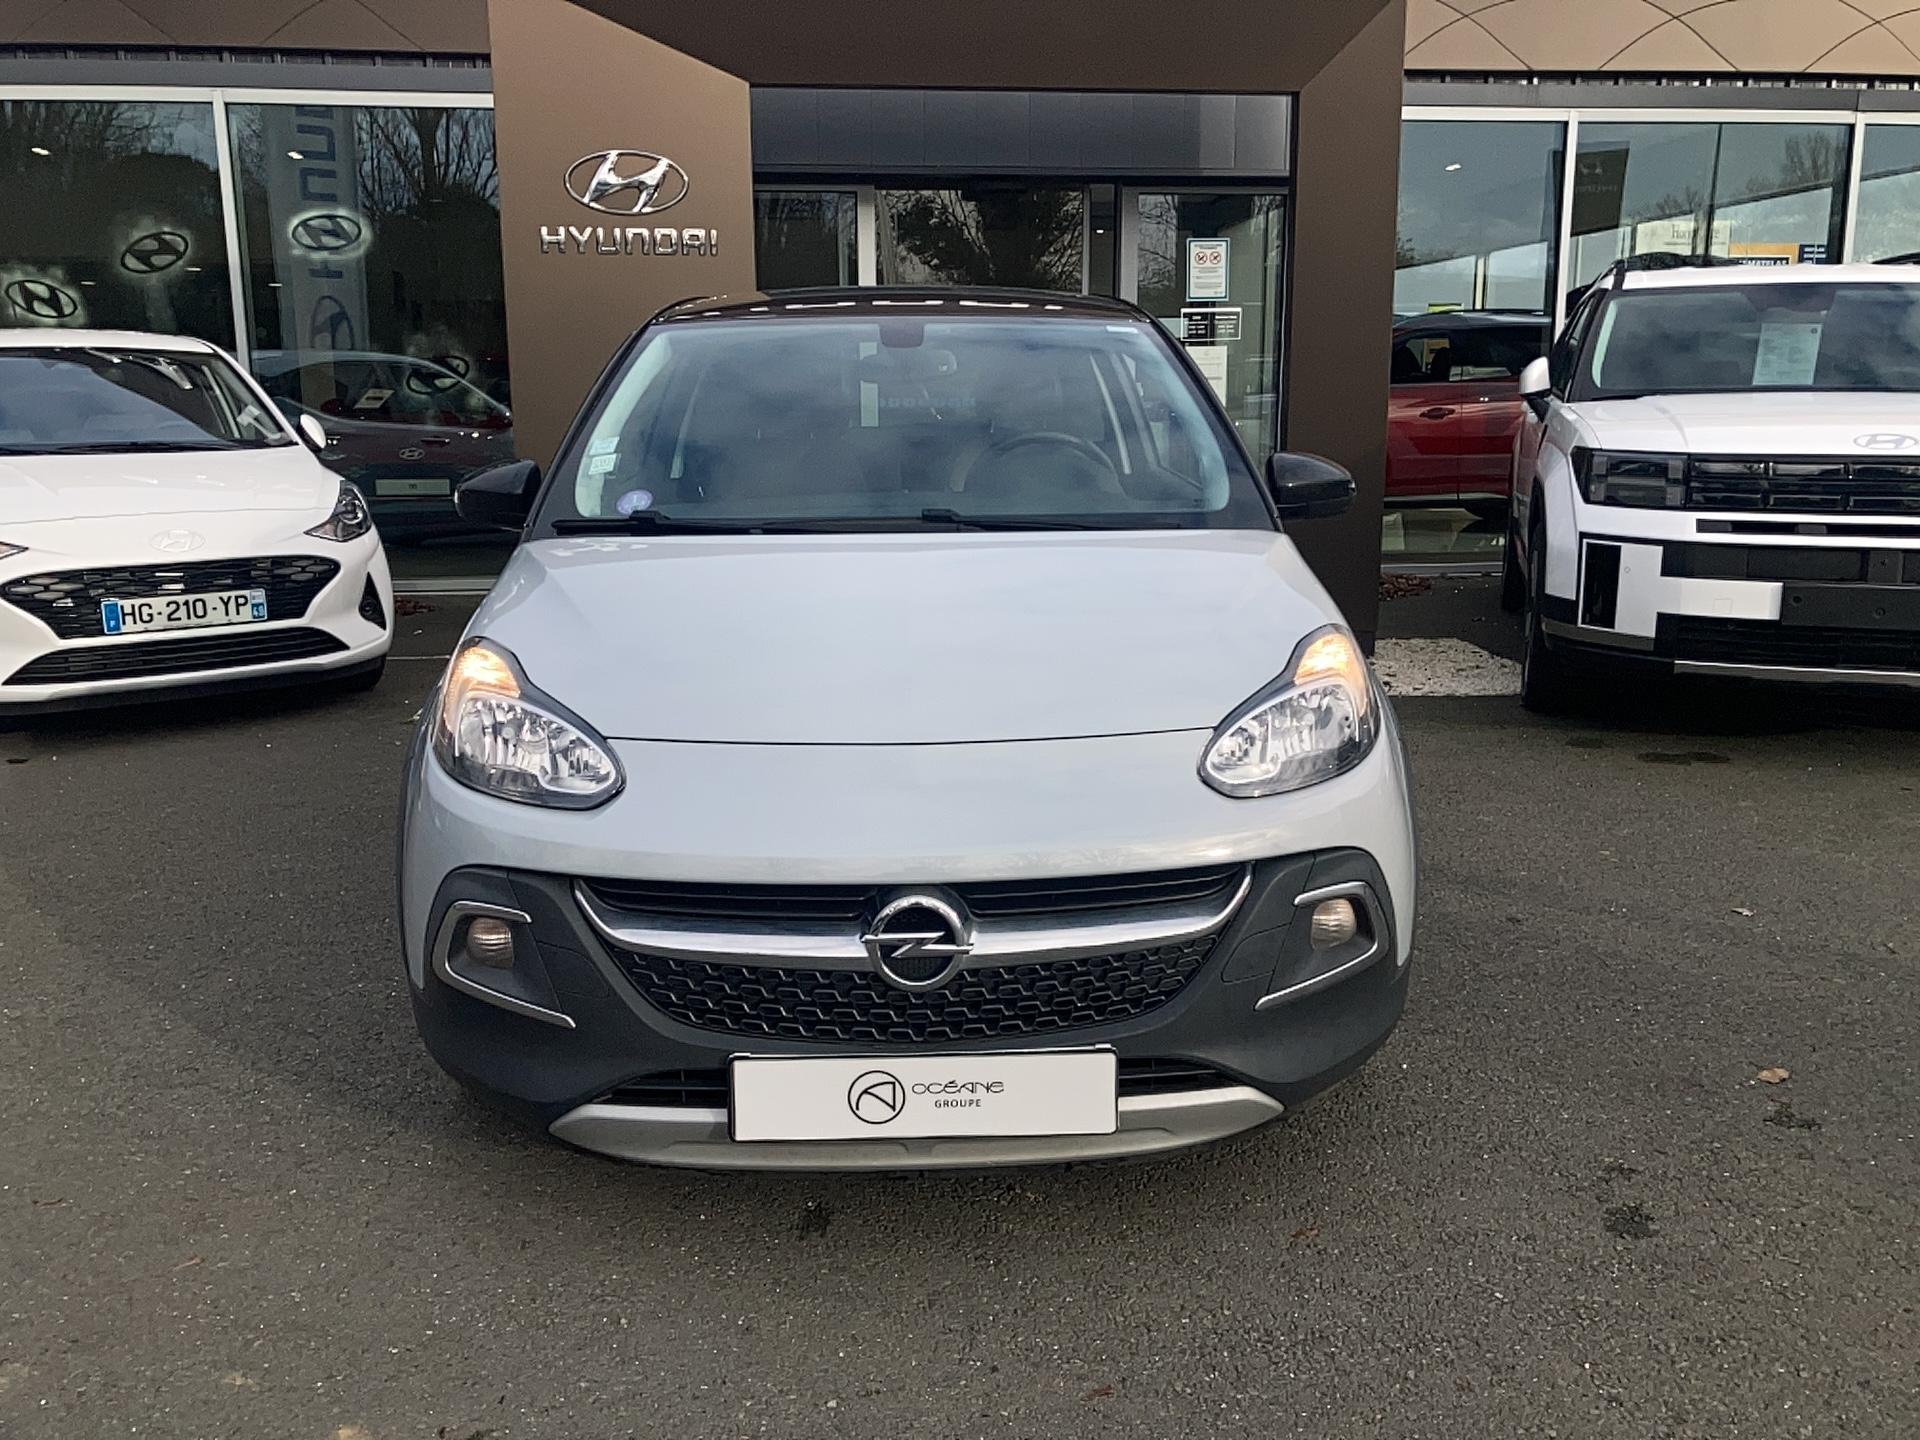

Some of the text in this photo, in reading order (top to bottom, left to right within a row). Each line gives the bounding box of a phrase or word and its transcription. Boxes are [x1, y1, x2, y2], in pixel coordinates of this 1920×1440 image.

[540, 226, 718, 256] HYUNDAI
[120, 594, 249, 626] HG-210-YP
[911, 1080, 1005, 1095] OCÉANE
[934, 1099, 982, 1108] GROUPE
